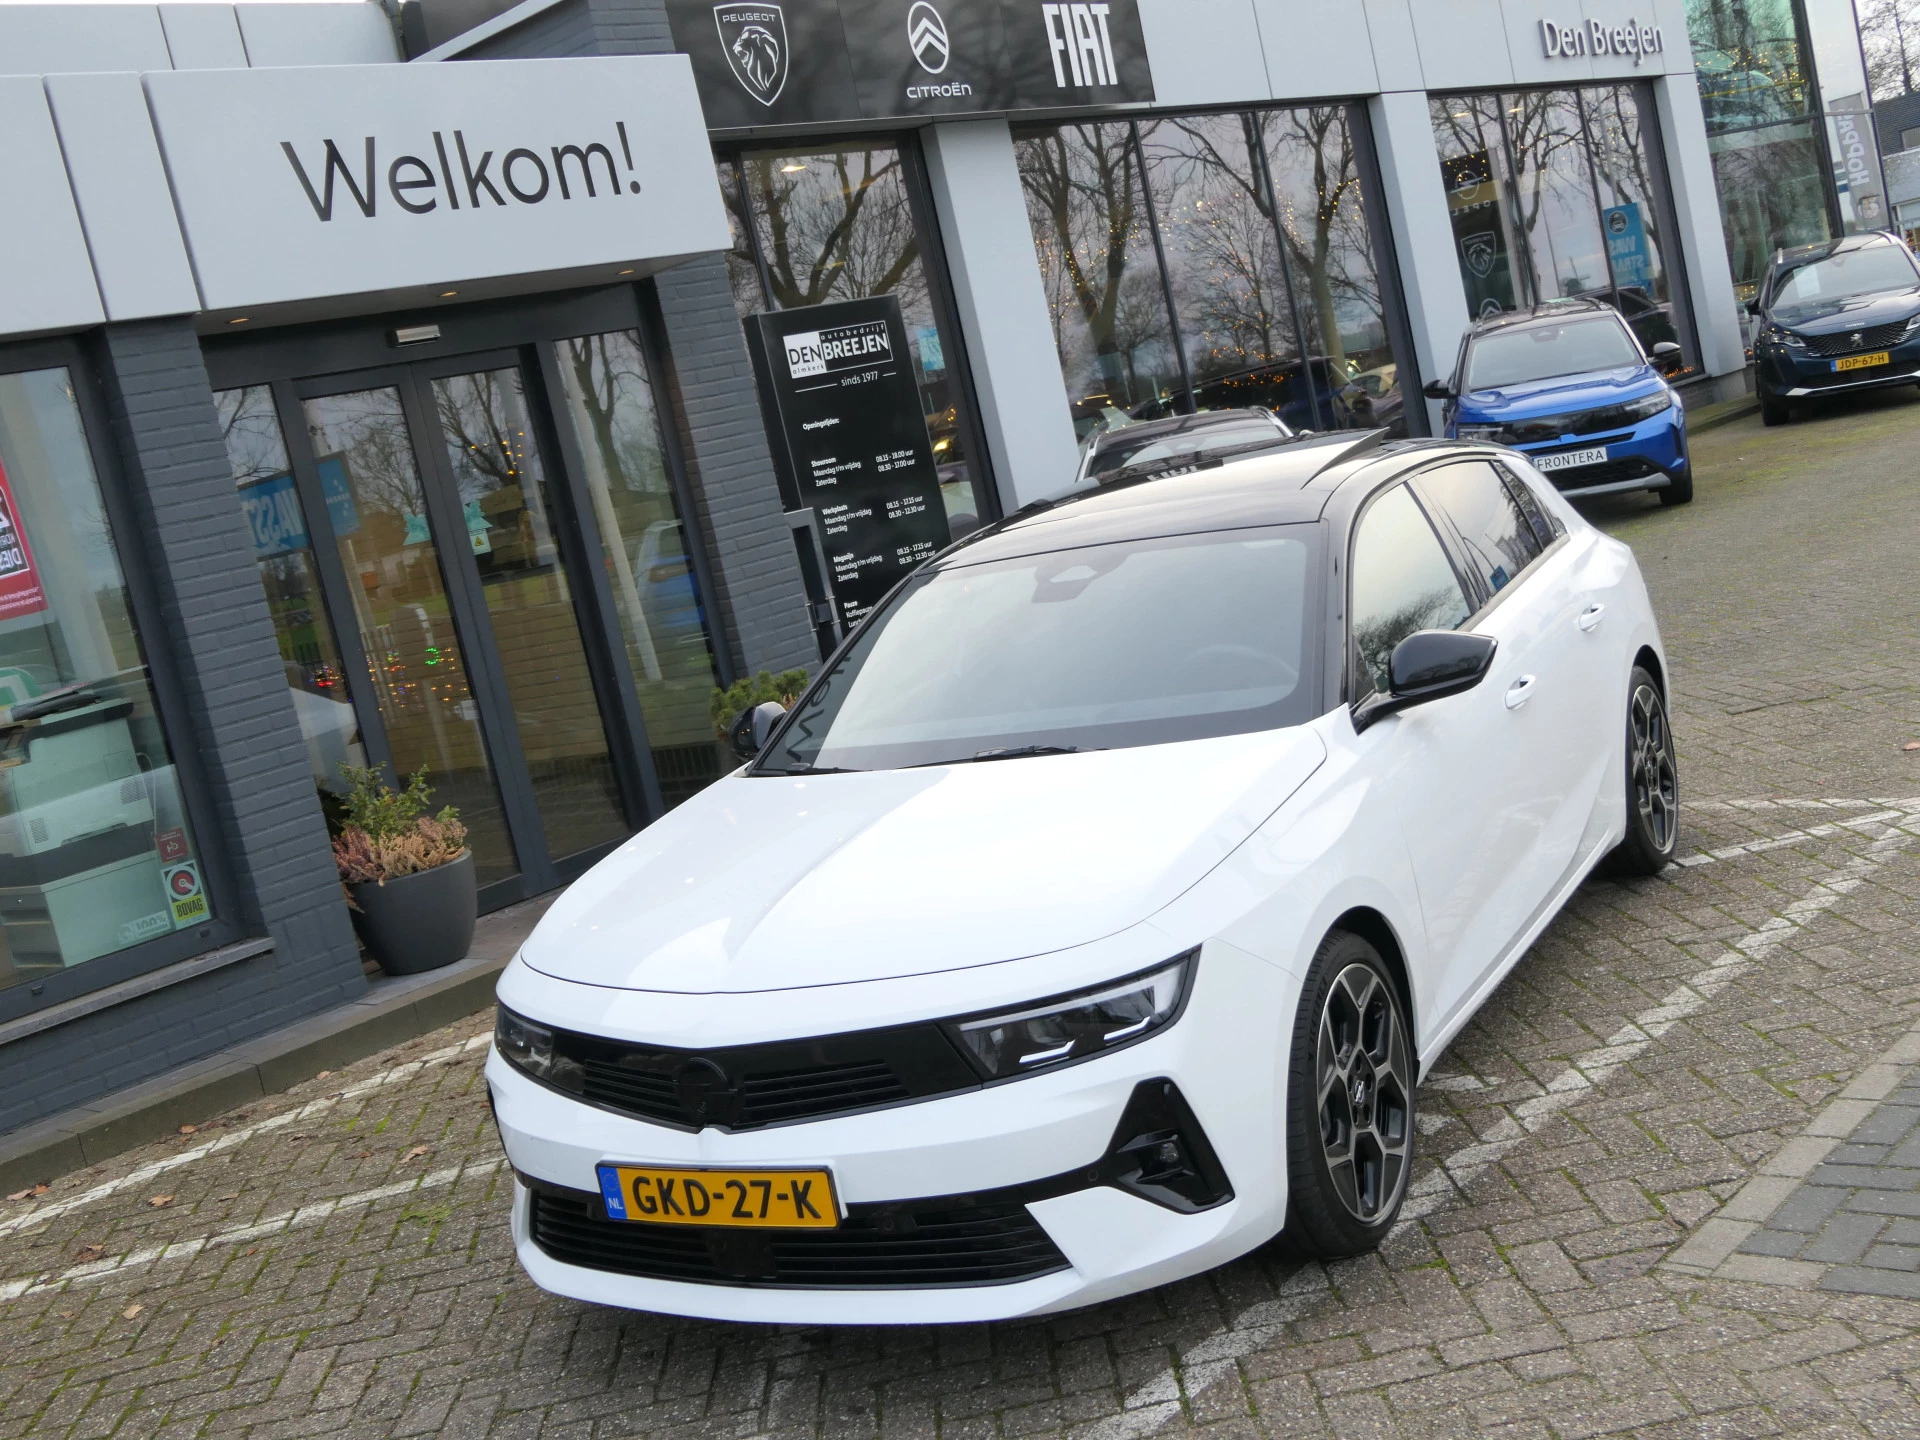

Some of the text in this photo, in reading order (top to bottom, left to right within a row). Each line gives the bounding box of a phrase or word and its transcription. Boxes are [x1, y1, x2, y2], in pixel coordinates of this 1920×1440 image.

[722, 13, 776, 24] PEUGEOT
[1042, 3, 1118, 88] FIAT
[1538, 17, 1665, 67] Den Breejen
[280, 121, 642, 222] Welkom!
[820, 323, 884, 340] autobedrijf
[788, 333, 889, 365] DEN BREEJEN
[793, 364, 824, 375] almkerk
[1839, 354, 1885, 370] JDP-67-H
[841, 371, 878, 386] sinds 1977
[811, 457, 836, 468] Showroom
[1537, 449, 1604, 469] FRONTERA
[813, 467, 836, 477] Maandag
[844, 461, 861, 470] vrijdag
[815, 477, 837, 487] Zaterdag
[822, 504, 848, 516] Werkplaats
[824, 515, 847, 525] Maandag
[855, 508, 872, 518] vrijdag
[827, 525, 848, 535] Zaterdag
[835, 562, 857, 572] Maandag
[865, 555, 883, 565] vrijdag
[837, 571, 859, 582] Zaterdag
[176, 897, 204, 918] BOVAG
[609, 1176, 821, 1219] NL GKD-27-K
